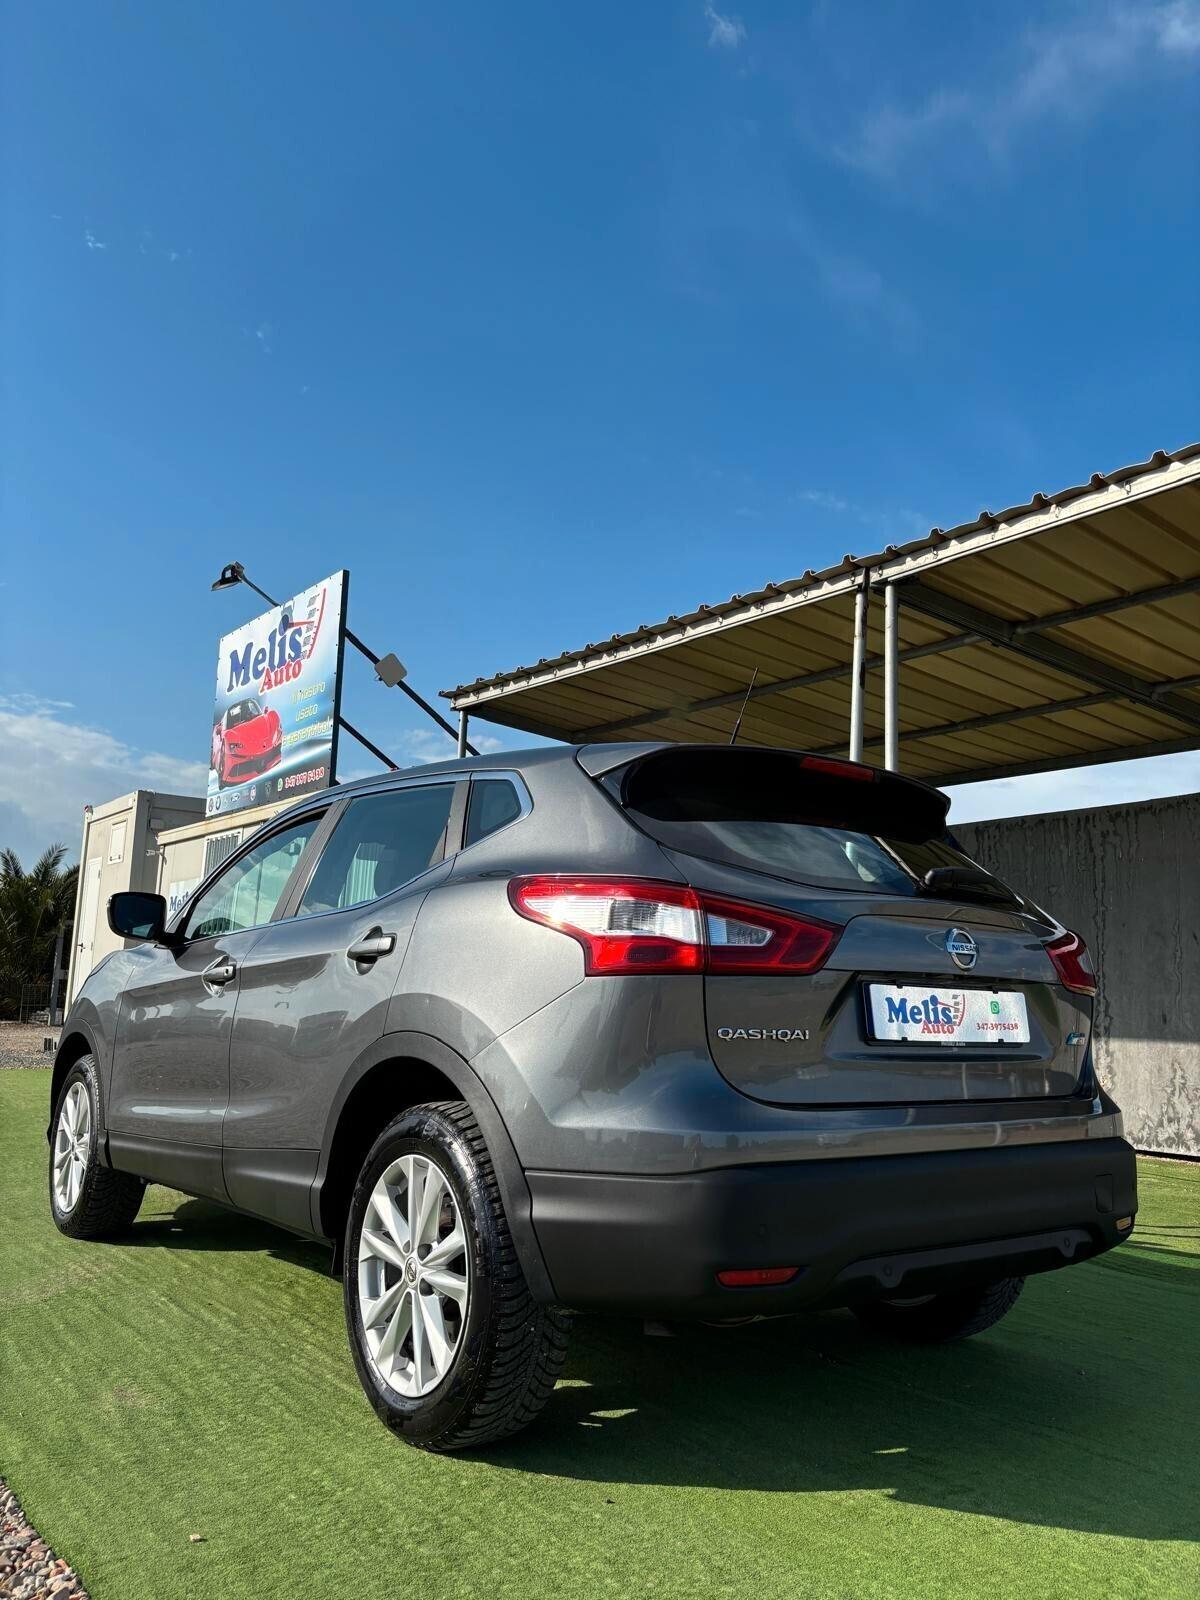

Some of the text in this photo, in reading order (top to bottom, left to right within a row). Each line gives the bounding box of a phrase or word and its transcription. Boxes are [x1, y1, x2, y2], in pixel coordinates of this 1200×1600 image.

[227, 614, 302, 692] Melis
[260, 660, 303, 694] Auto
[885, 994, 953, 1024] Melis
[717, 1027, 810, 1042] QASHQAI
[921, 1020, 955, 1034] Auto
